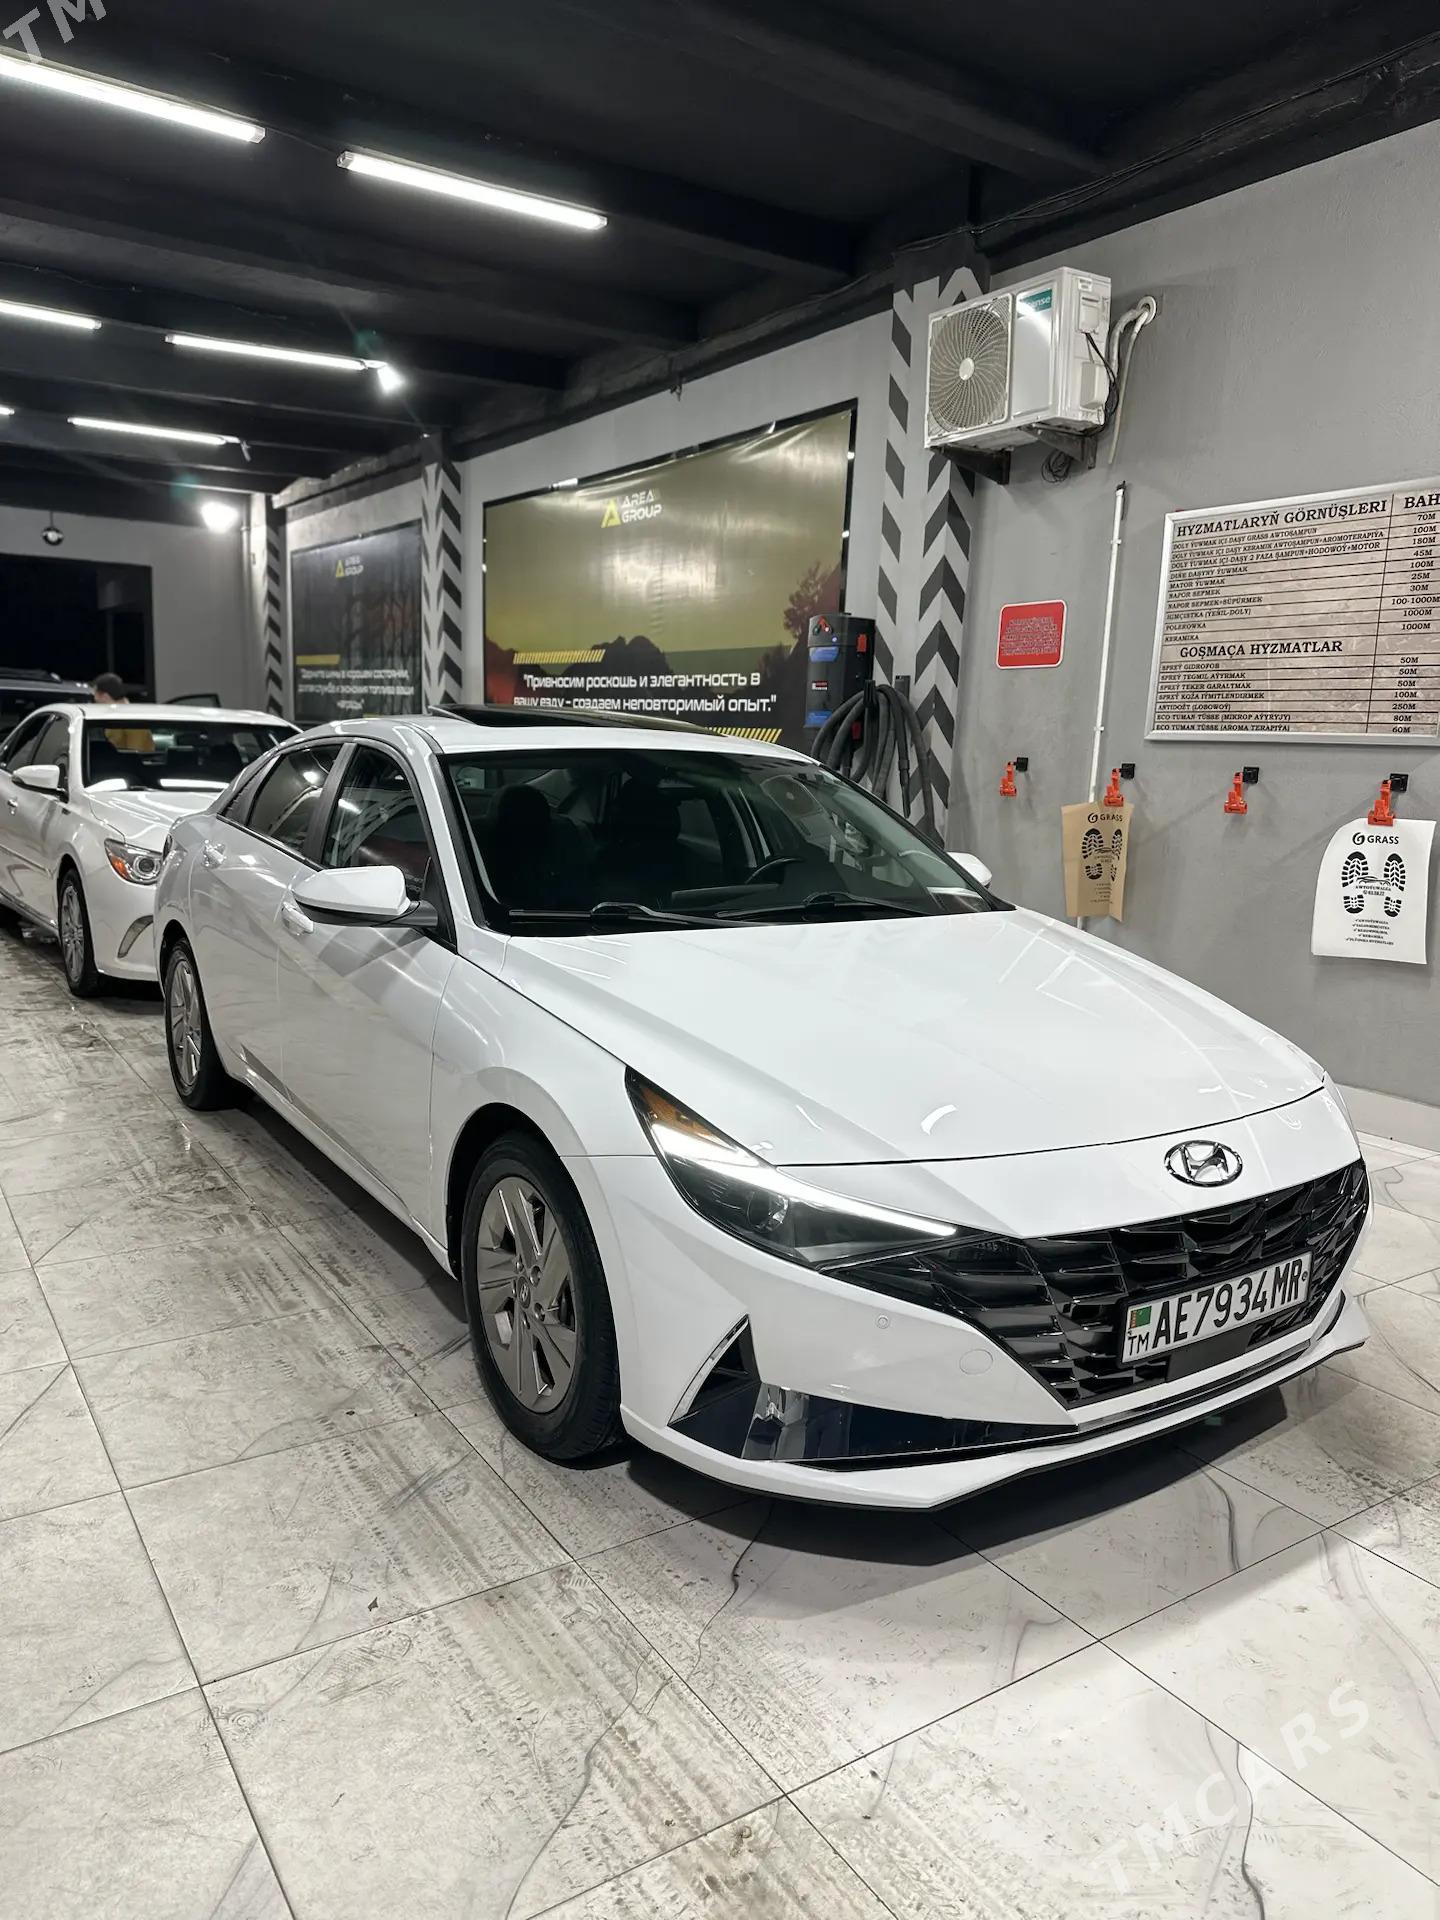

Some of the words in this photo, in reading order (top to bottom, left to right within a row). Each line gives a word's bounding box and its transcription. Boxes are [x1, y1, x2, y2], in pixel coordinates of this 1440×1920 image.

[621, 489, 654, 508] AREA
[622, 504, 662, 523] GROUP
[1418, 513, 1436, 521] 70M
[1177, 511, 1280, 537] HYZMATLARYŇ
[1284, 499, 1388, 523] GÖRNÜŞLERI
[1413, 525, 1437, 533] 100M
[1247, 533, 1269, 541] GRASS
[1412, 537, 1436, 545] 180M
[1413, 549, 1432, 557] 45M
[1410, 560, 1434, 568] 100M
[1411, 572, 1430, 580] 25M
[1170, 581, 1193, 589] MATOR
[1410, 584, 1429, 592] 30M
[1169, 591, 1191, 599] NAPOR
[1192, 589, 1220, 597] SEPMEK
[1391, 596, 1440, 605] 100-1000M
[1168, 601, 1190, 609] NAPOR
[1403, 609, 1432, 617] 1000M
[1401, 622, 1431, 630] 1000M
[1164, 634, 1199, 642] KERAMIKA
[1180, 644, 1245, 659] GOŞMAÇA
[1250, 640, 1343, 655] HYZMATLAR
[1400, 656, 1419, 664] 50M
[1184, 662, 1220, 670] GIDROFOB
[523, 673, 585, 691] "Привносим
[586, 675, 637, 692] роскошь
[649, 673, 748, 687] элегантность
[572, 697, 621, 711] создаем
[622, 694, 725, 715] неповторимый
[728, 694, 777, 712] опыт."
[1100, 814, 1123, 822] GRASS
[1367, 835, 1399, 845] GRASS
[1128, 1332, 1150, 1356] TM
